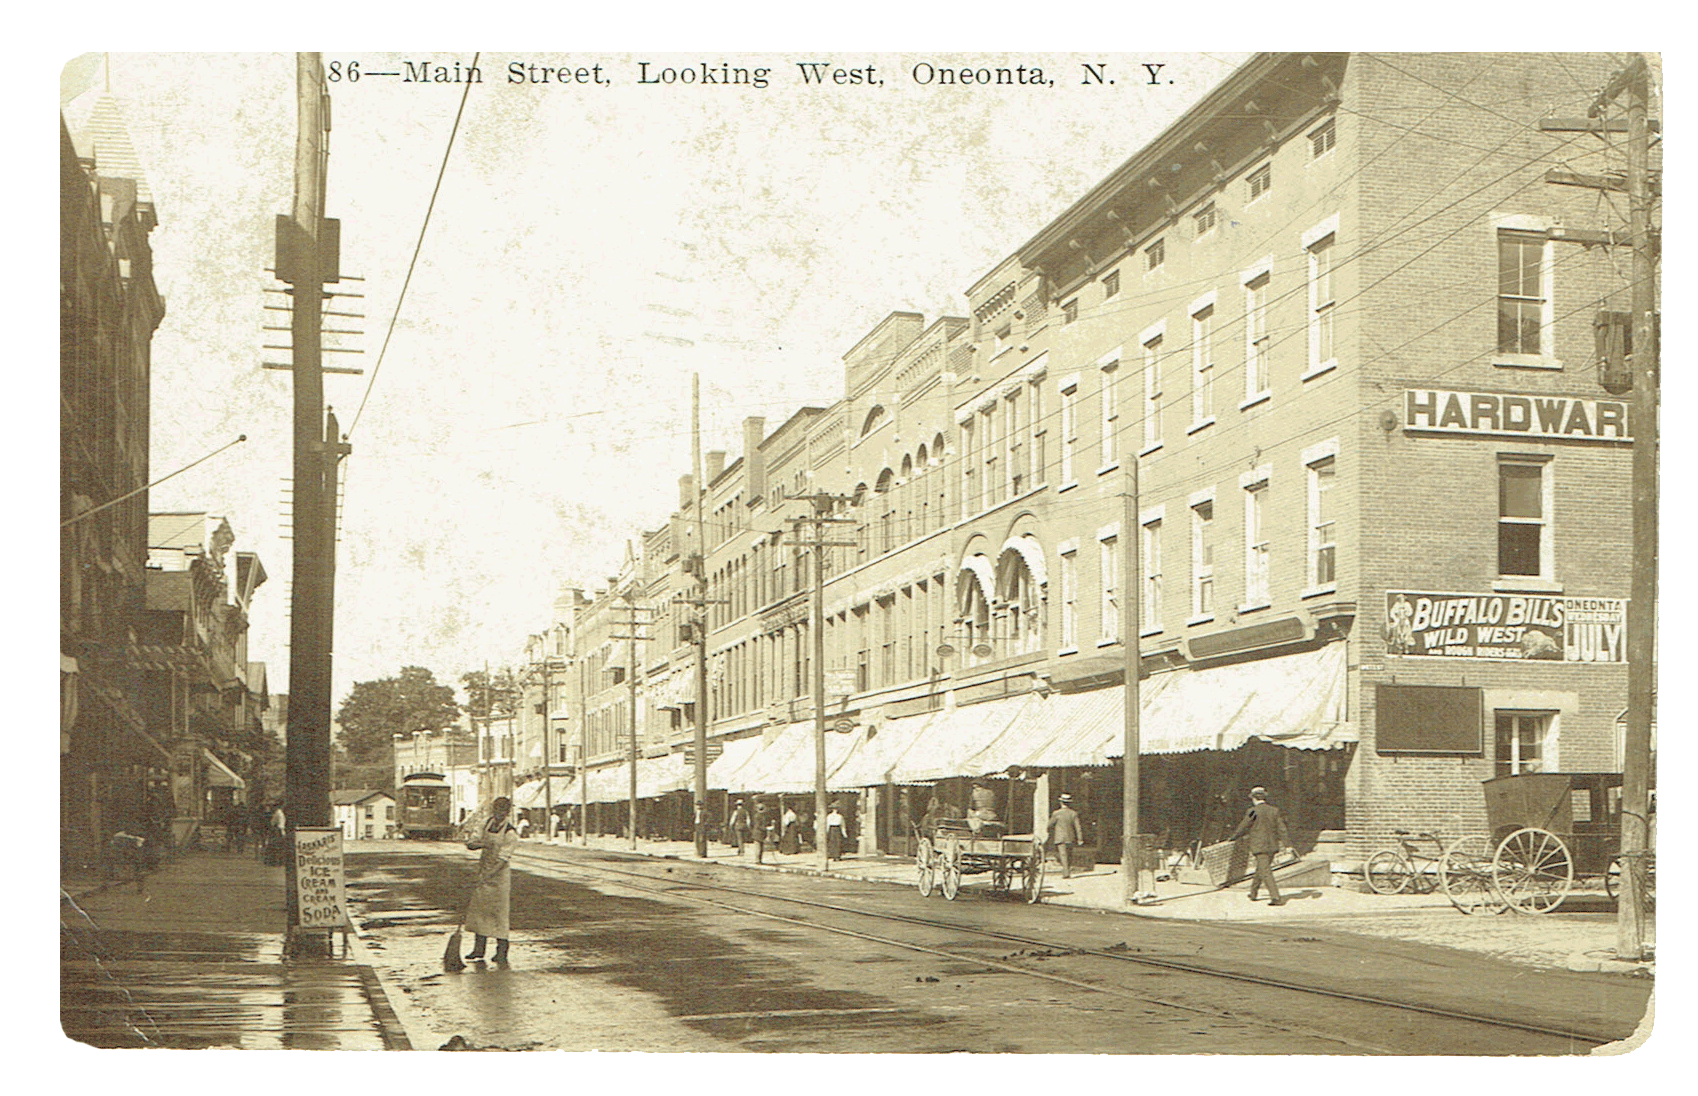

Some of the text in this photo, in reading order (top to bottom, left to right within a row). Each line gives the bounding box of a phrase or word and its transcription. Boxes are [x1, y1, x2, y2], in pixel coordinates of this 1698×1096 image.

[1407, 391, 1633, 437] HARDWAR
[1412, 597, 1503, 632] BUFFALO
[1566, 600, 1621, 611] ONEONTA
[1424, 626, 1526, 649] WILD WEST
[1566, 624, 1622, 661] JULY
[310, 865, 331, 877] ICE
